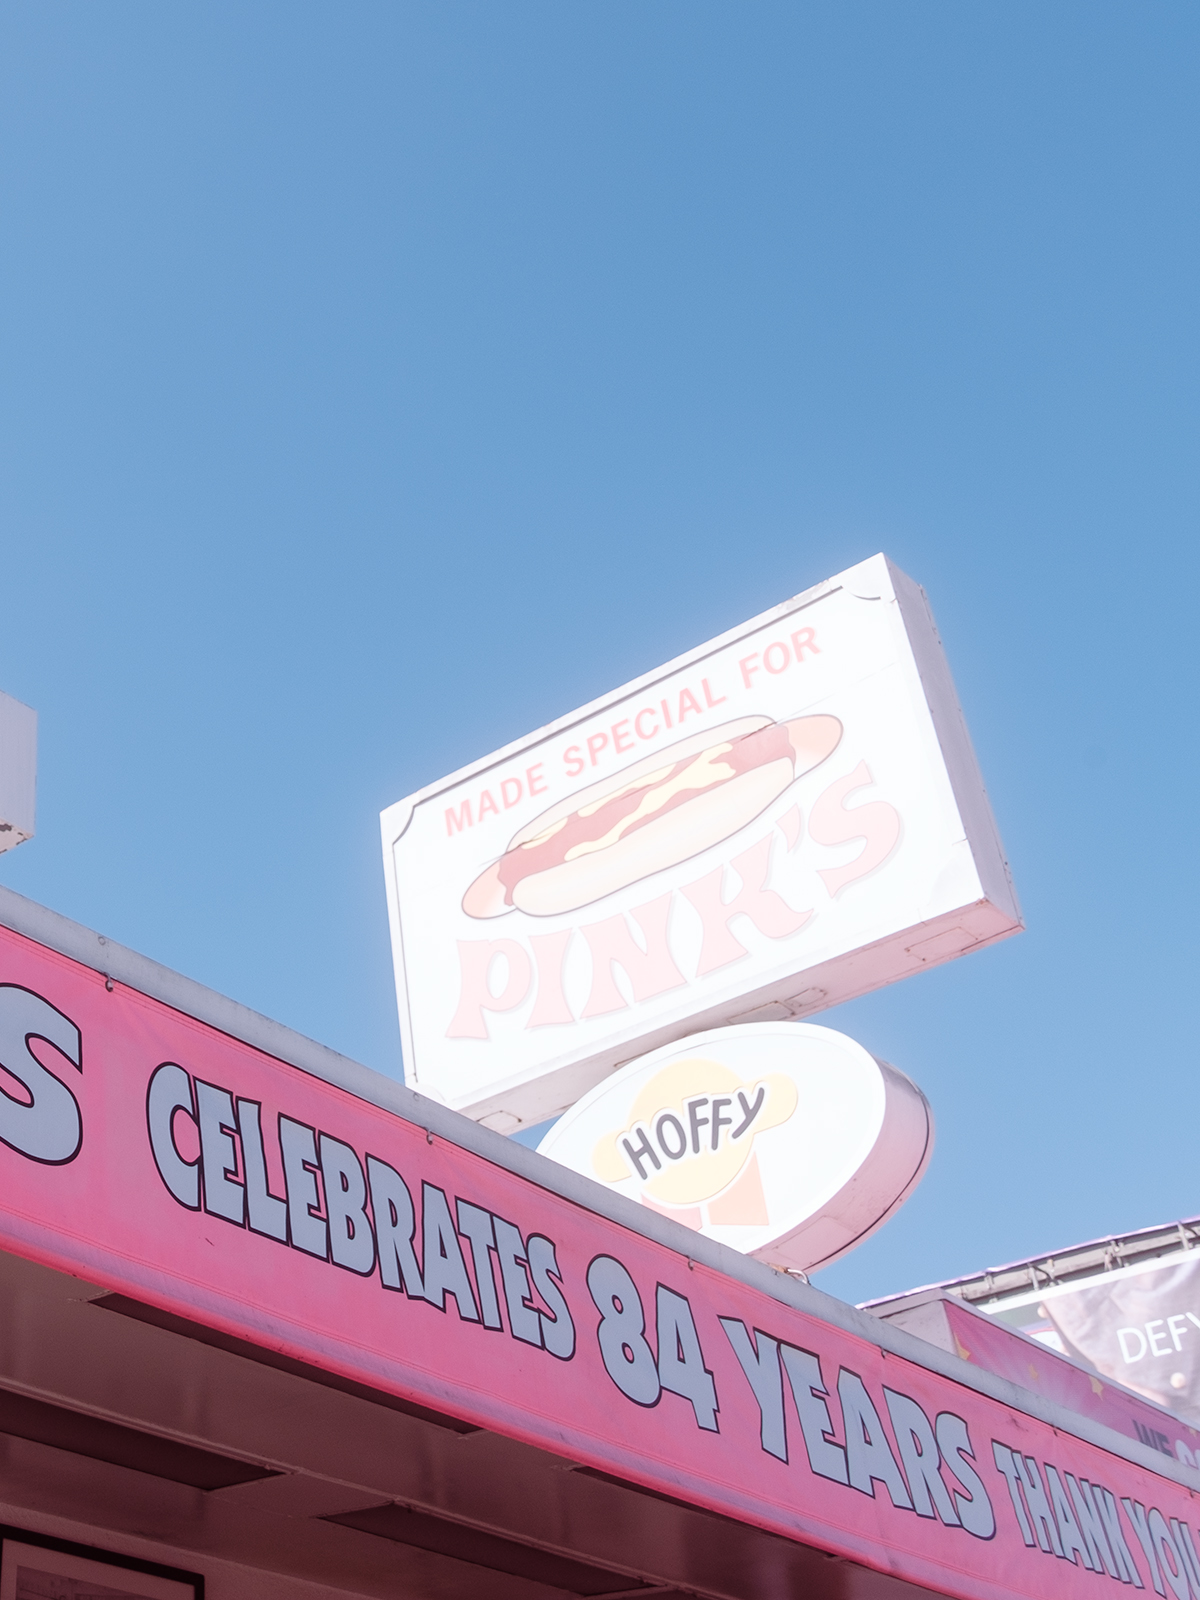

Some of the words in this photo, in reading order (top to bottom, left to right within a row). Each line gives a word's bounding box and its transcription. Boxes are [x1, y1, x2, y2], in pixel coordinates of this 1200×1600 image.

[443, 763, 550, 837] MADE
[561, 677, 728, 778] SPECIAL
[738, 625, 822, 689] FOR
[443, 758, 904, 1041] PINK'S
[622, 1086, 766, 1180] HOFFY
[146, 1061, 575, 1361] CELEBRATES
[586, 1254, 719, 1432] 84
[719, 1315, 996, 1540] YEARS
[991, 1438, 1145, 1590] THANK
